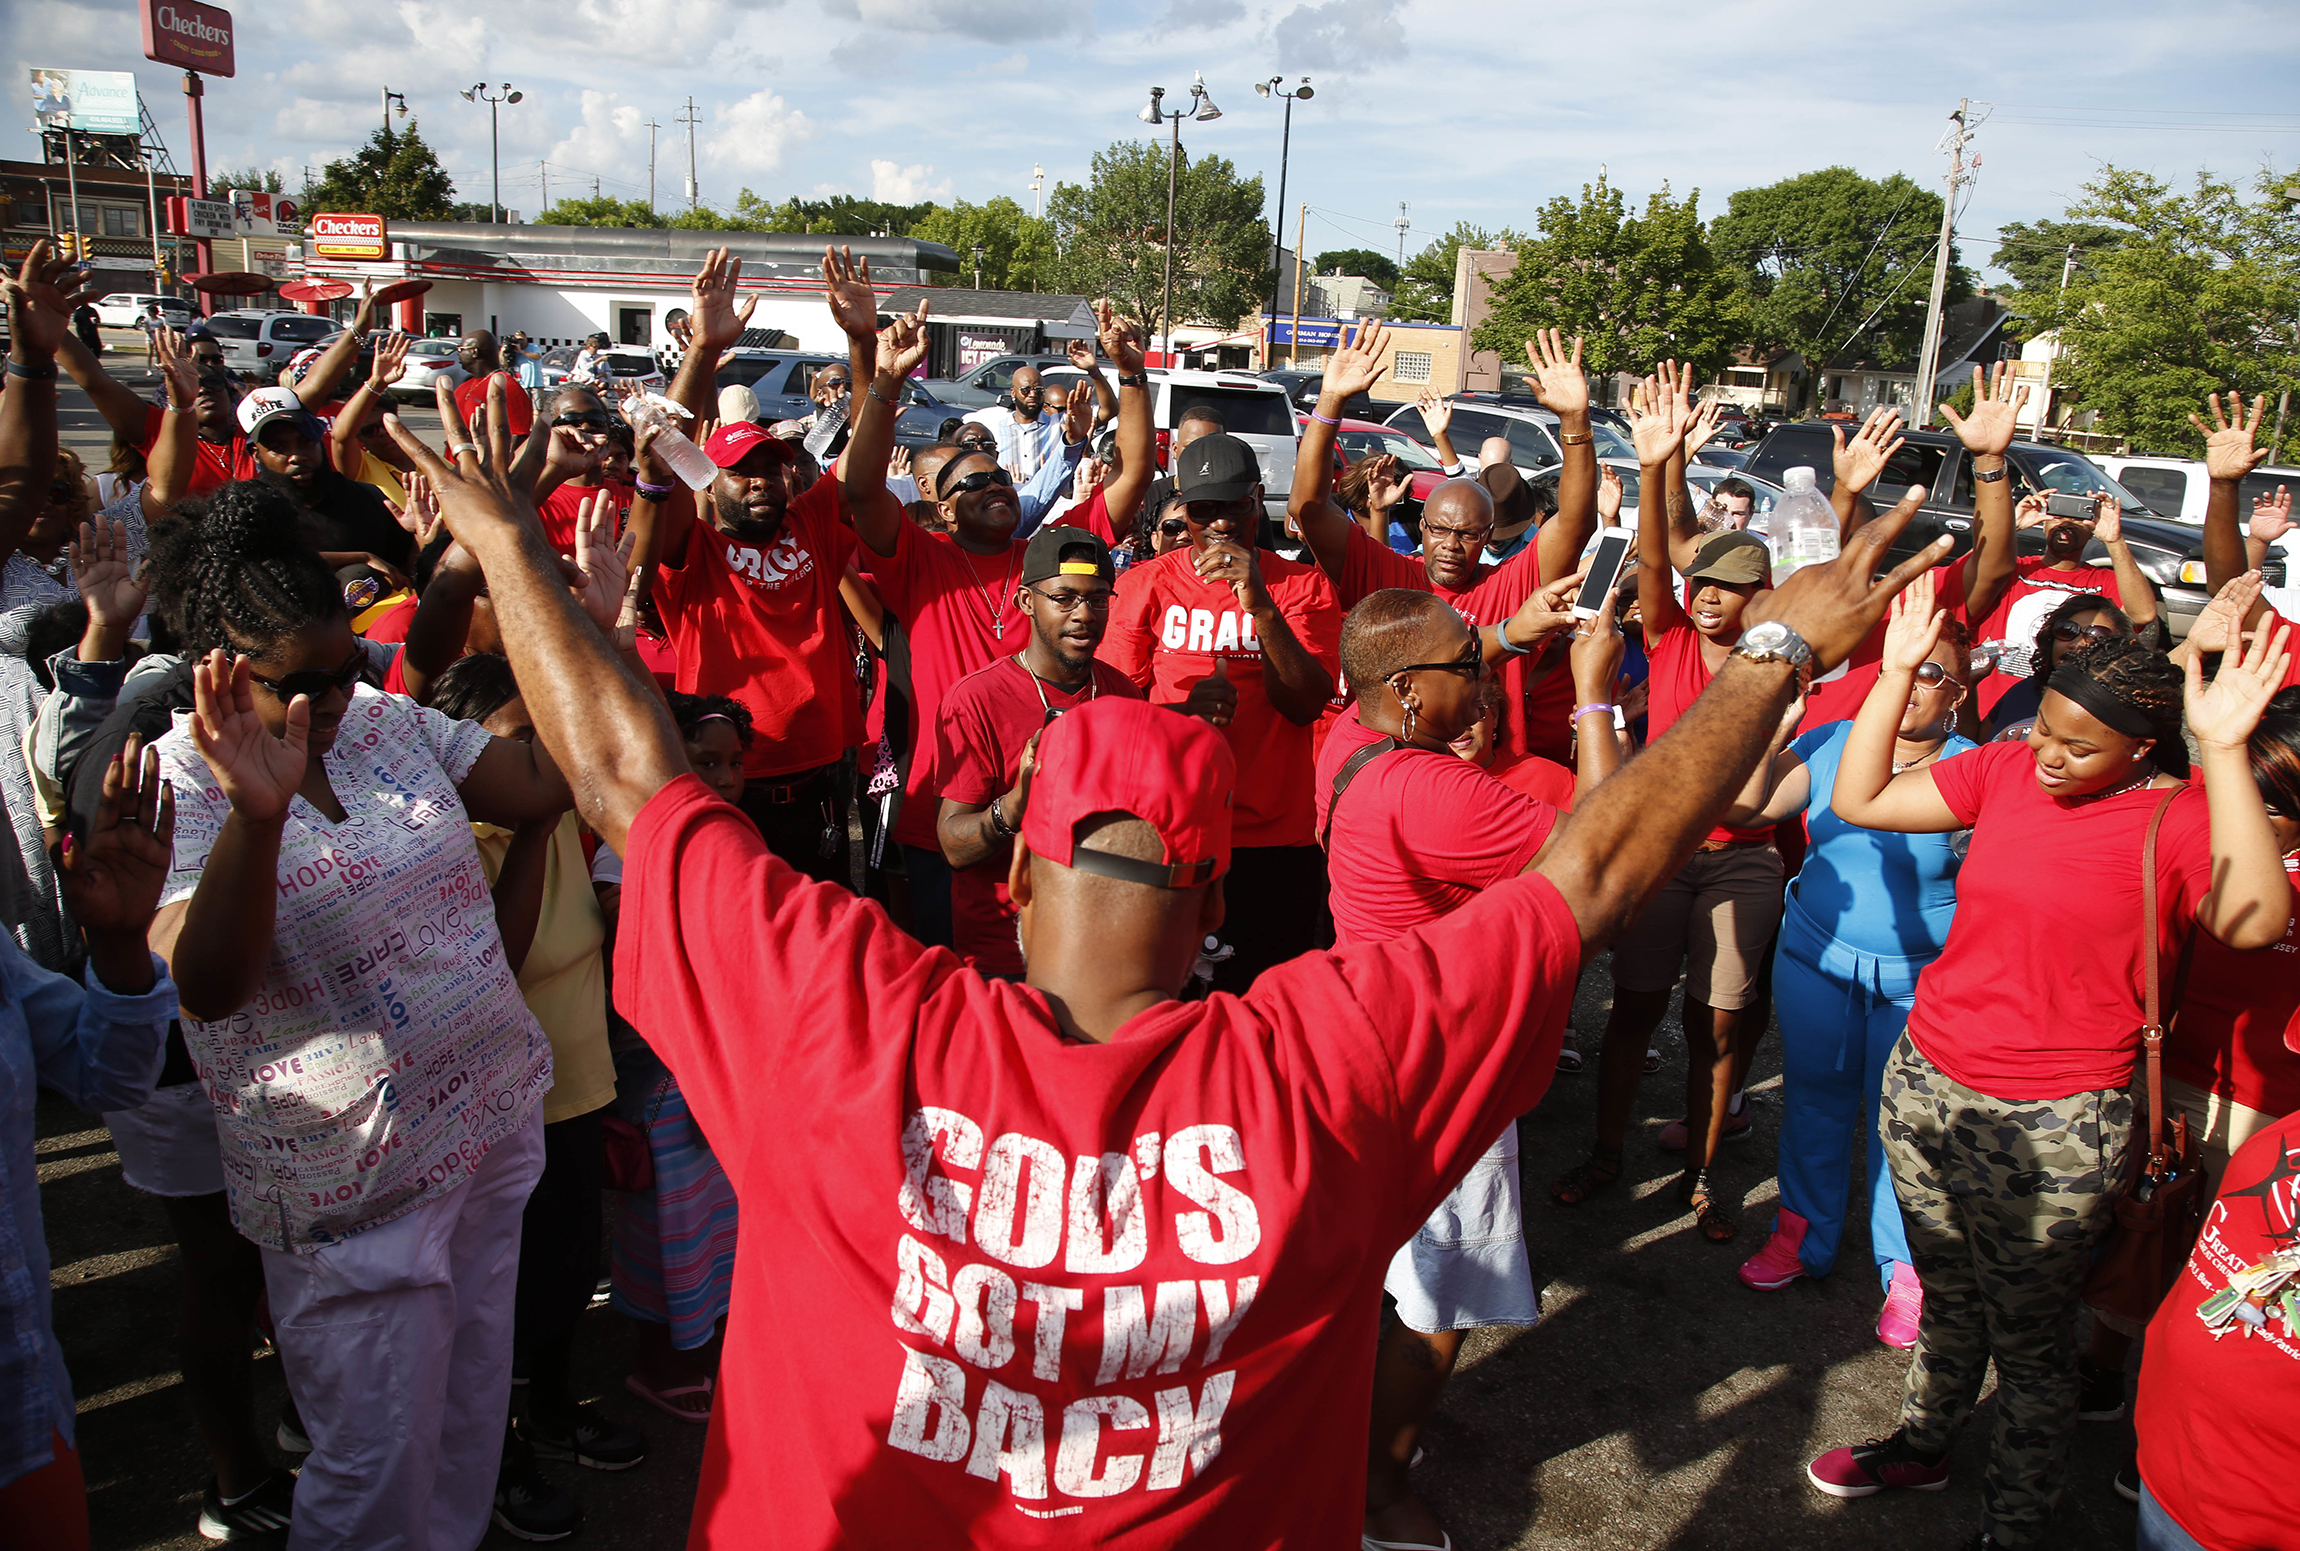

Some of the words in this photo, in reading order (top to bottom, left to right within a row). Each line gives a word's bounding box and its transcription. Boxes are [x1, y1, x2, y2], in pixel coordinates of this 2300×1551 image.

[158, 6, 229, 45] Checkers
[75, 82, 128, 103] Advance
[193, 210, 217, 219] CHICKEN
[196, 202, 207, 210] FOR
[254, 205, 269, 214] KFC
[316, 219, 380, 236] Checkers
[961, 350, 978, 364] ICY
[250, 399, 287, 423] #SELFIE
[759, 582, 780, 590] THE
[1162, 605, 1260, 651] GRAC
[403, 794, 456, 830] CARE
[409, 841, 446, 867] PASSION
[339, 855, 382, 884] LOVE
[444, 861, 468, 881] HOPE
[347, 872, 379, 896] HOPE
[439, 872, 471, 901] LOVE
[424, 893, 459, 919] Courage
[463, 927, 488, 948] CARE
[335, 931, 406, 985] CARE
[344, 954, 410, 998] Peace
[404, 969, 454, 1005] Courage
[341, 999, 379, 1023] CARE
[379, 977, 410, 1030] LOVE
[413, 992, 441, 1015] CARE
[431, 994, 475, 1028] PASSION
[266, 1010, 333, 1040] Laugh
[349, 1016, 391, 1049] Laugh
[244, 1042, 281, 1057] CARE
[304, 1043, 344, 1062] CARE
[306, 1051, 349, 1071] Courage
[358, 1048, 399, 1073] Passion
[458, 1038, 487, 1060] CARE
[480, 1041, 508, 1065] Peace
[249, 1057, 304, 1084] LOVE
[297, 1060, 356, 1086] PASSION
[424, 1049, 456, 1081] HOPE
[270, 1090, 308, 1110] HOPE
[426, 1071, 470, 1113] LOVE
[266, 1105, 312, 1120] Peace
[444, 1094, 474, 1119] CARE
[460, 1088, 499, 1124] Peace
[300, 1128, 338, 1143] CARE
[301, 1136, 344, 1152] Courage
[292, 1142, 349, 1162] PASSION
[355, 1132, 402, 1173] LOVE
[302, 1172, 355, 1188] Courage
[897, 1106, 1261, 1274] GOD'S
[308, 1181, 362, 1207] LOVE
[381, 1197, 434, 1221] Passion
[2202, 1200, 2251, 1272] GREAT
[2197, 1272, 2213, 1290] Burt
[890, 1233, 1084, 1384] GOT
[1094, 1275, 1260, 1386] MY
[887, 1339, 1236, 1500] BACK
[1041, 1511, 1049, 1519] IS
[1049, 1510, 1055, 1518] A
[1054, 1505, 1084, 1517] WITNESS
